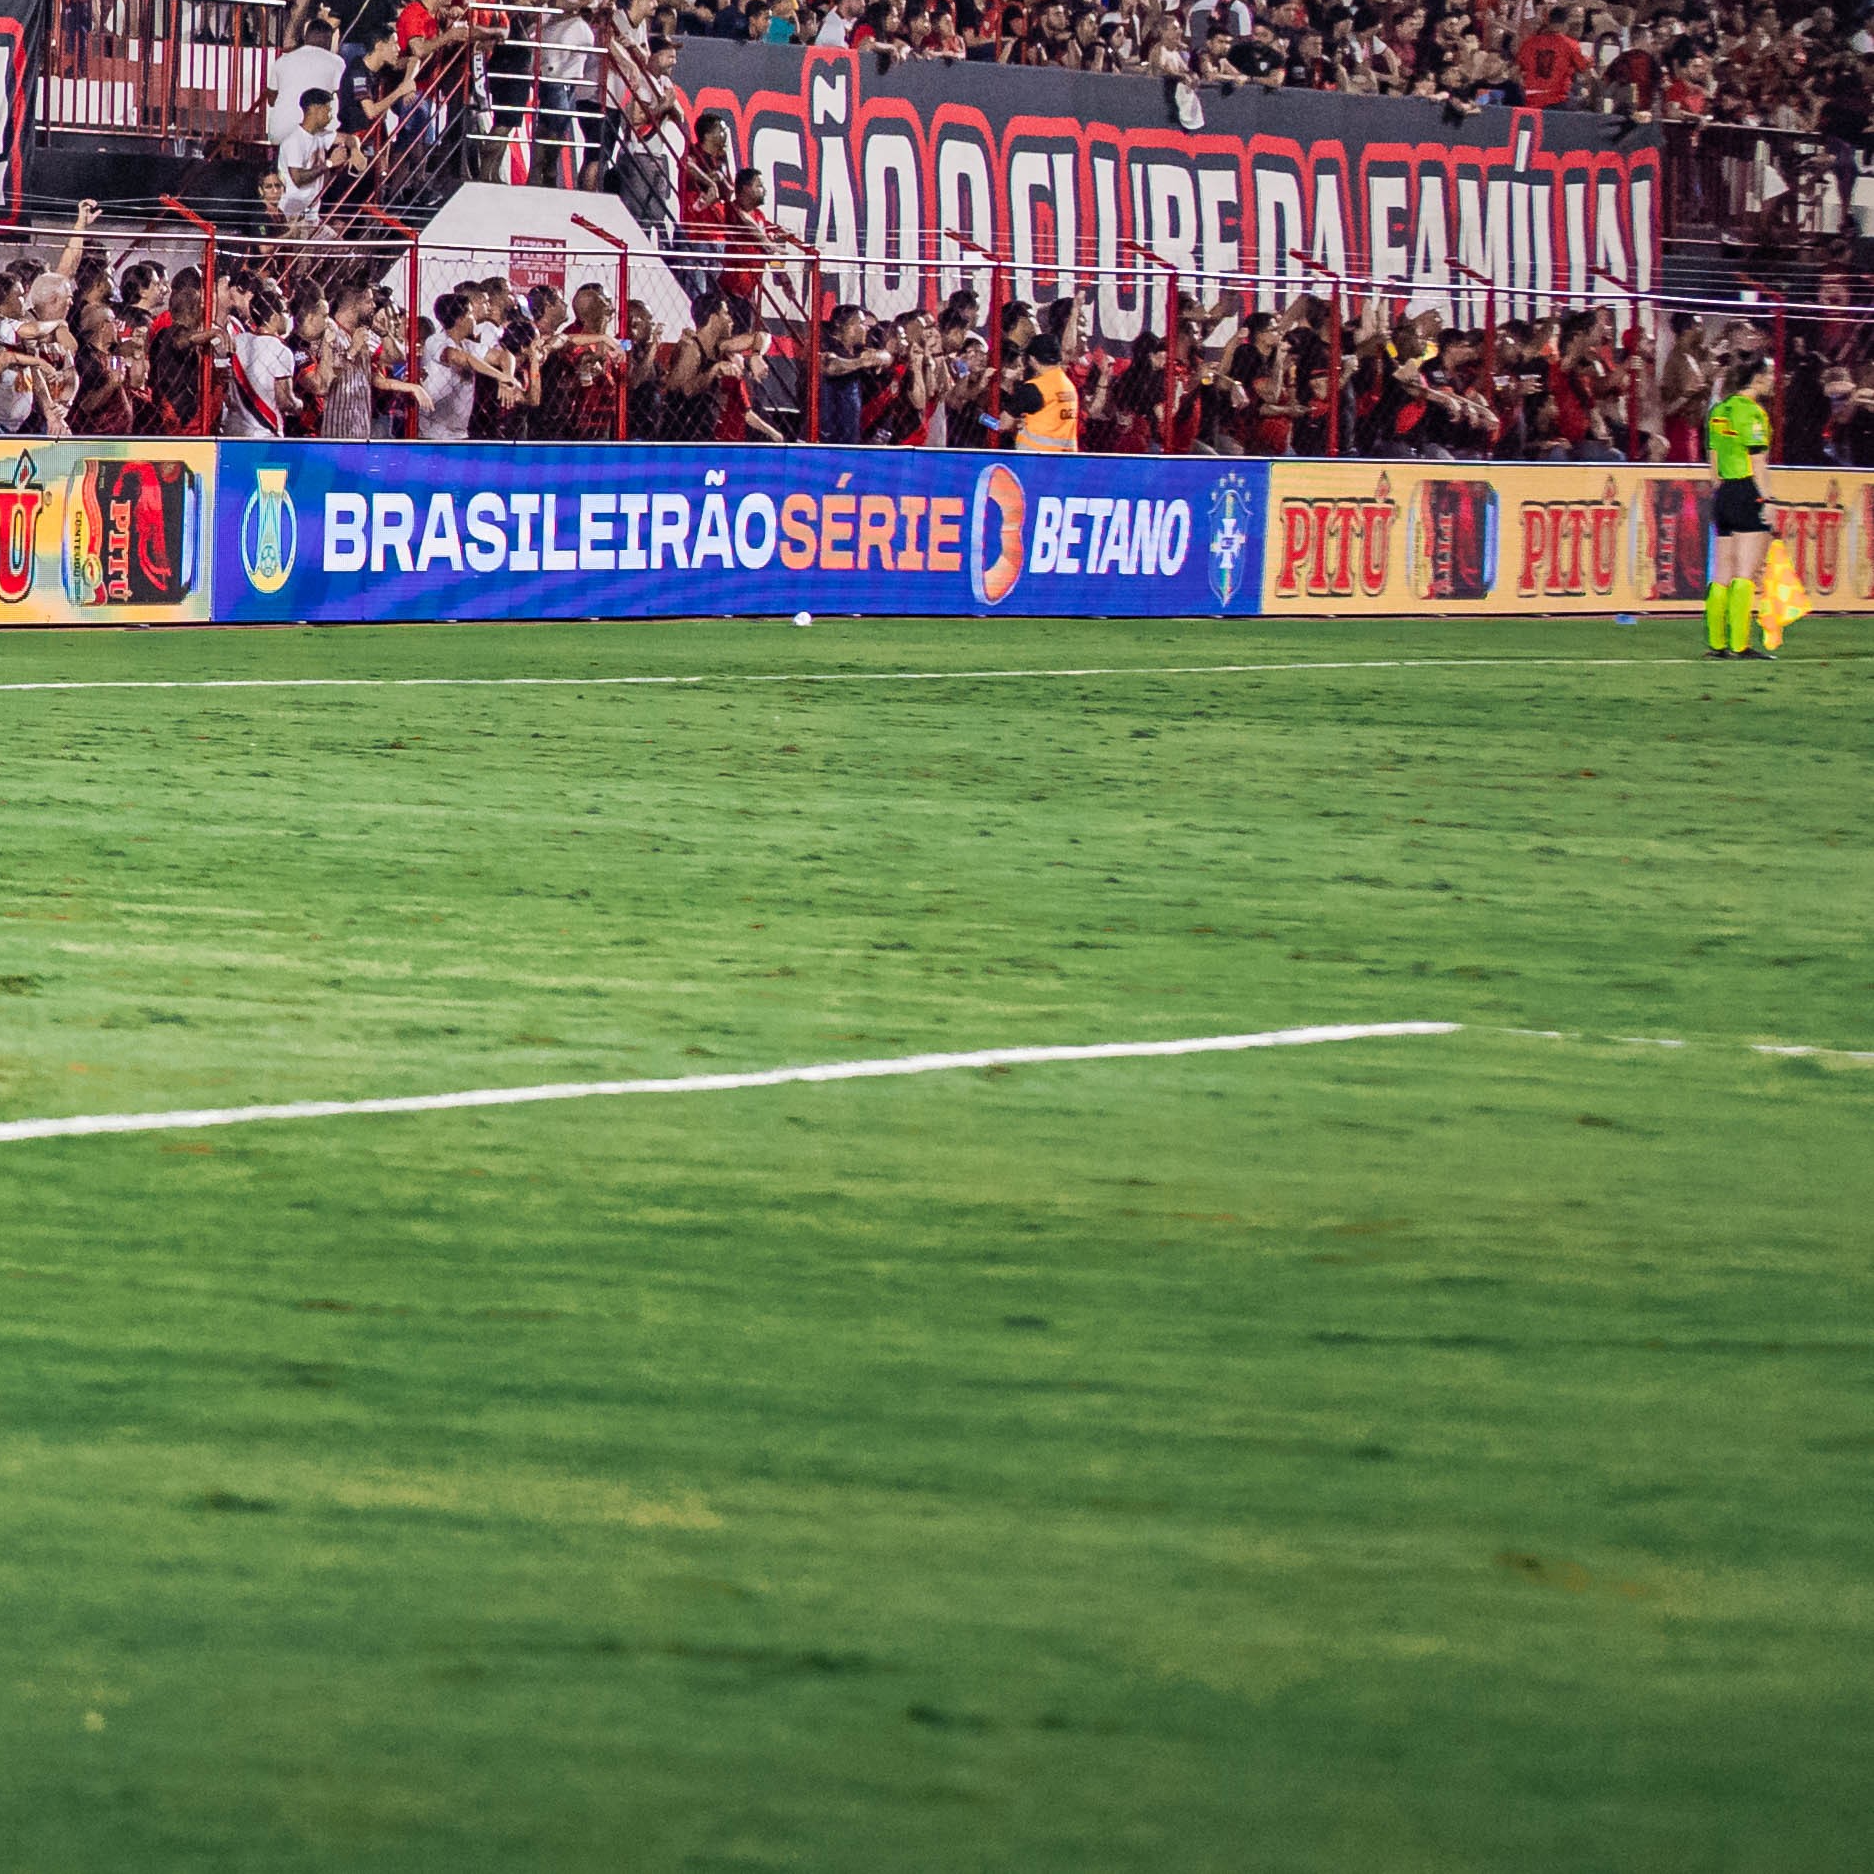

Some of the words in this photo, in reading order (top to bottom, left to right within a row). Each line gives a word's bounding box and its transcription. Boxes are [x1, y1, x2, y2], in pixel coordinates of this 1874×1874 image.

[1029, 496, 1191, 577] BETANO
[1274, 469, 1397, 599] PITÚ
[1517, 475, 1625, 599] PITÚ
